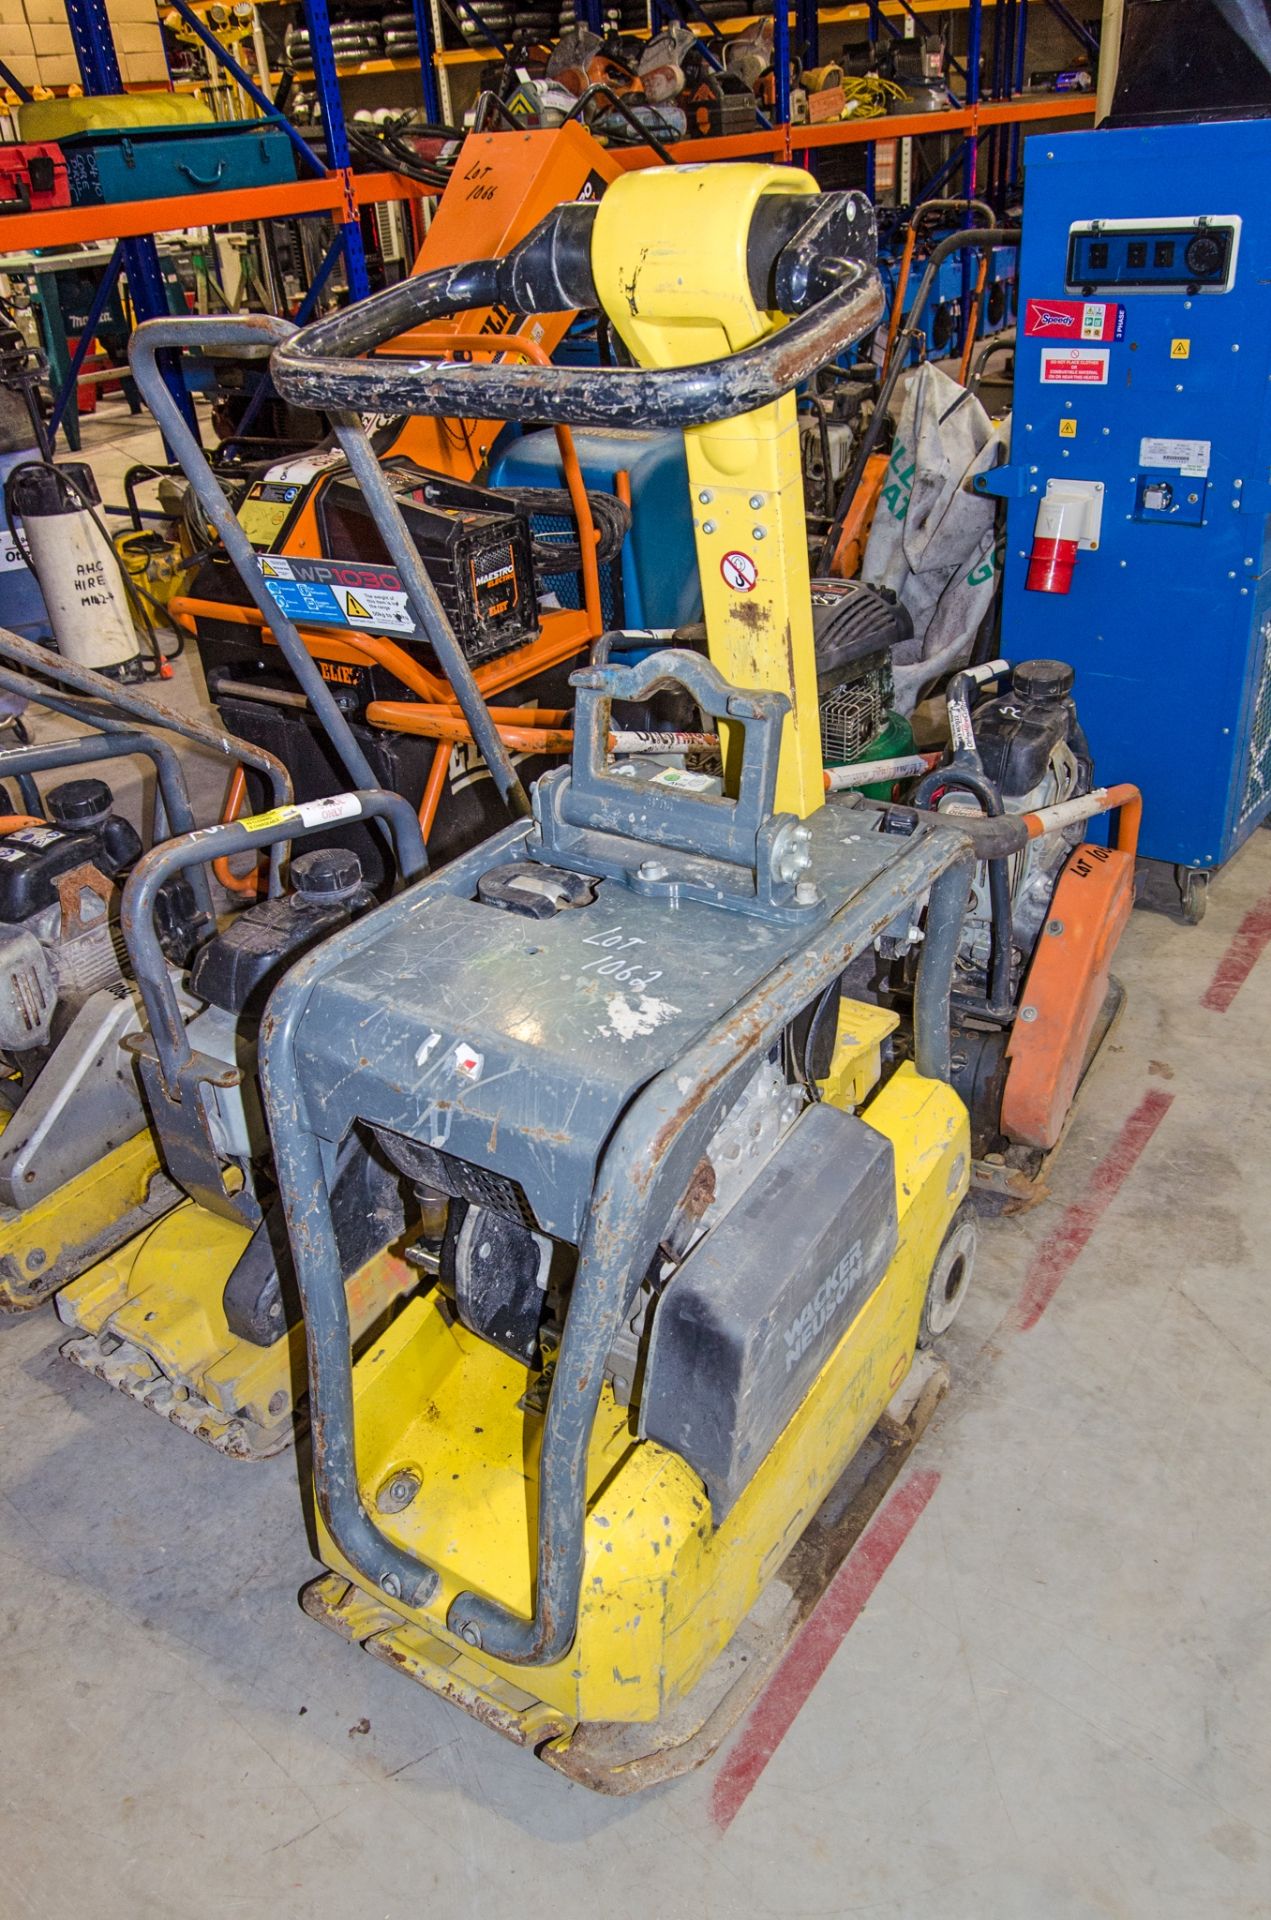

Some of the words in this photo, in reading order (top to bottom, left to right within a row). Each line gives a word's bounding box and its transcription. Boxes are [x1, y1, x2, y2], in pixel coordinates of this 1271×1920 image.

[463, 160, 493, 180] LOT
[465, 184, 498, 200] 1066
[1041, 312, 1075, 327] Speedy
[1117, 309, 1126, 333] PHASE
[74, 576, 105, 590] HIRE
[291, 564, 401, 591] WP1030
[476, 565, 514, 587] MAESTRO
[319, 662, 360, 686] ELIE
[1069, 858, 1093, 878] LOT
[582, 926, 647, 950] LOT
[581, 955, 663, 989] 1062
[783, 1239, 863, 1347] WACKER
[785, 1267, 863, 1373] NEUSON
